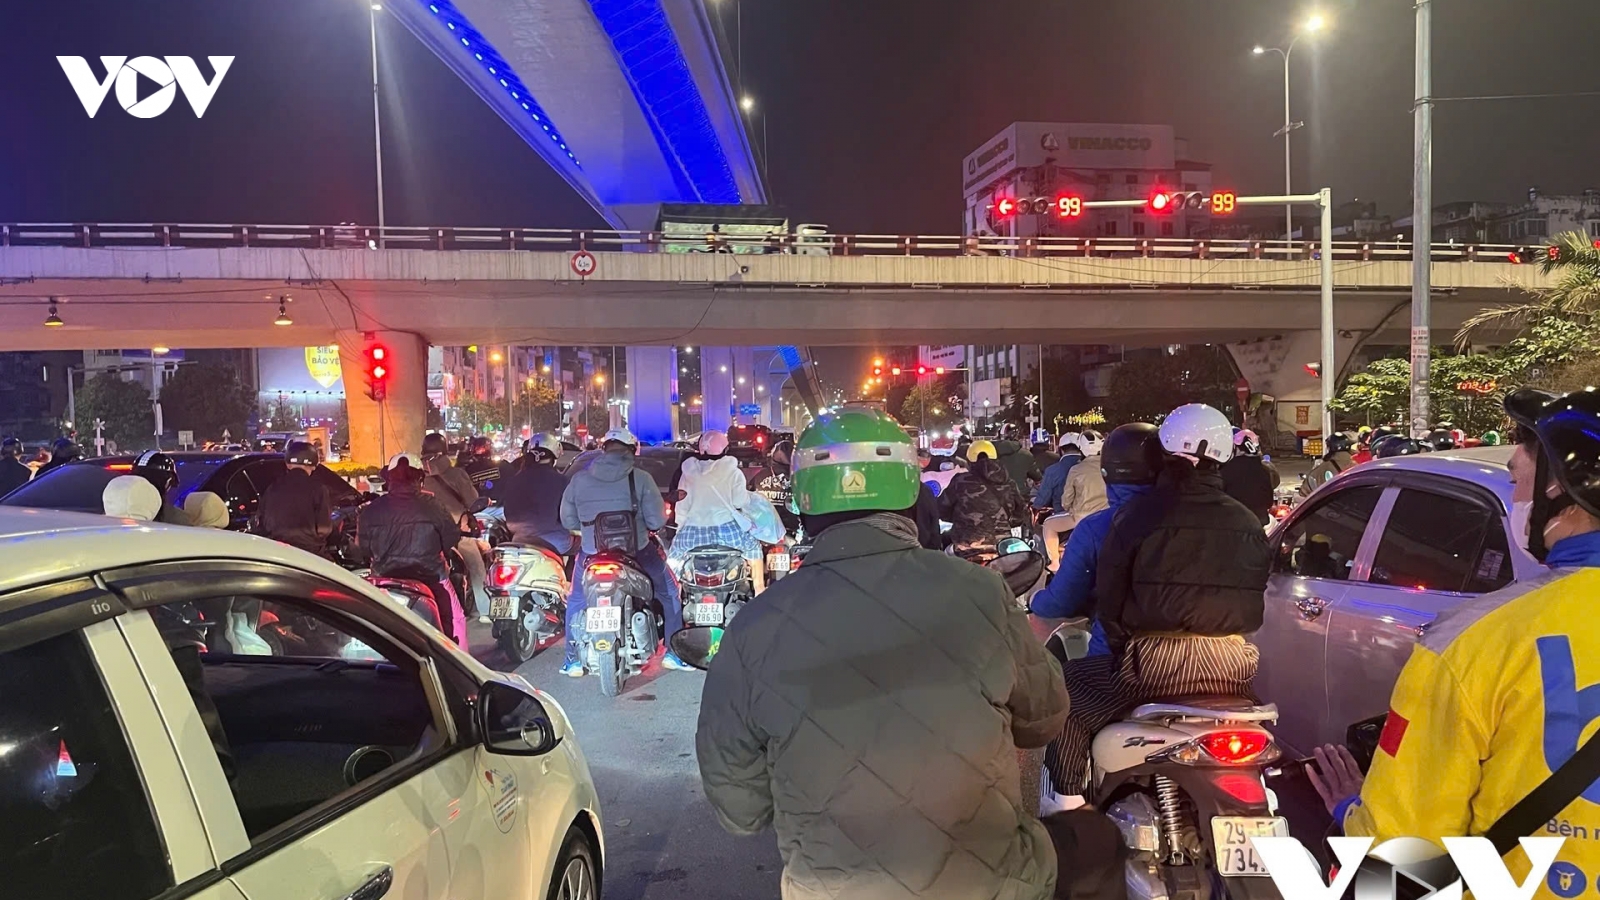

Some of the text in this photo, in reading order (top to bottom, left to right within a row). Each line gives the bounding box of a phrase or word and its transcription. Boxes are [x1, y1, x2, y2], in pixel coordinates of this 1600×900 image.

[1058, 197, 1082, 217] 99
[1212, 193, 1235, 213] 99
[1546, 818, 1587, 839] Bên
